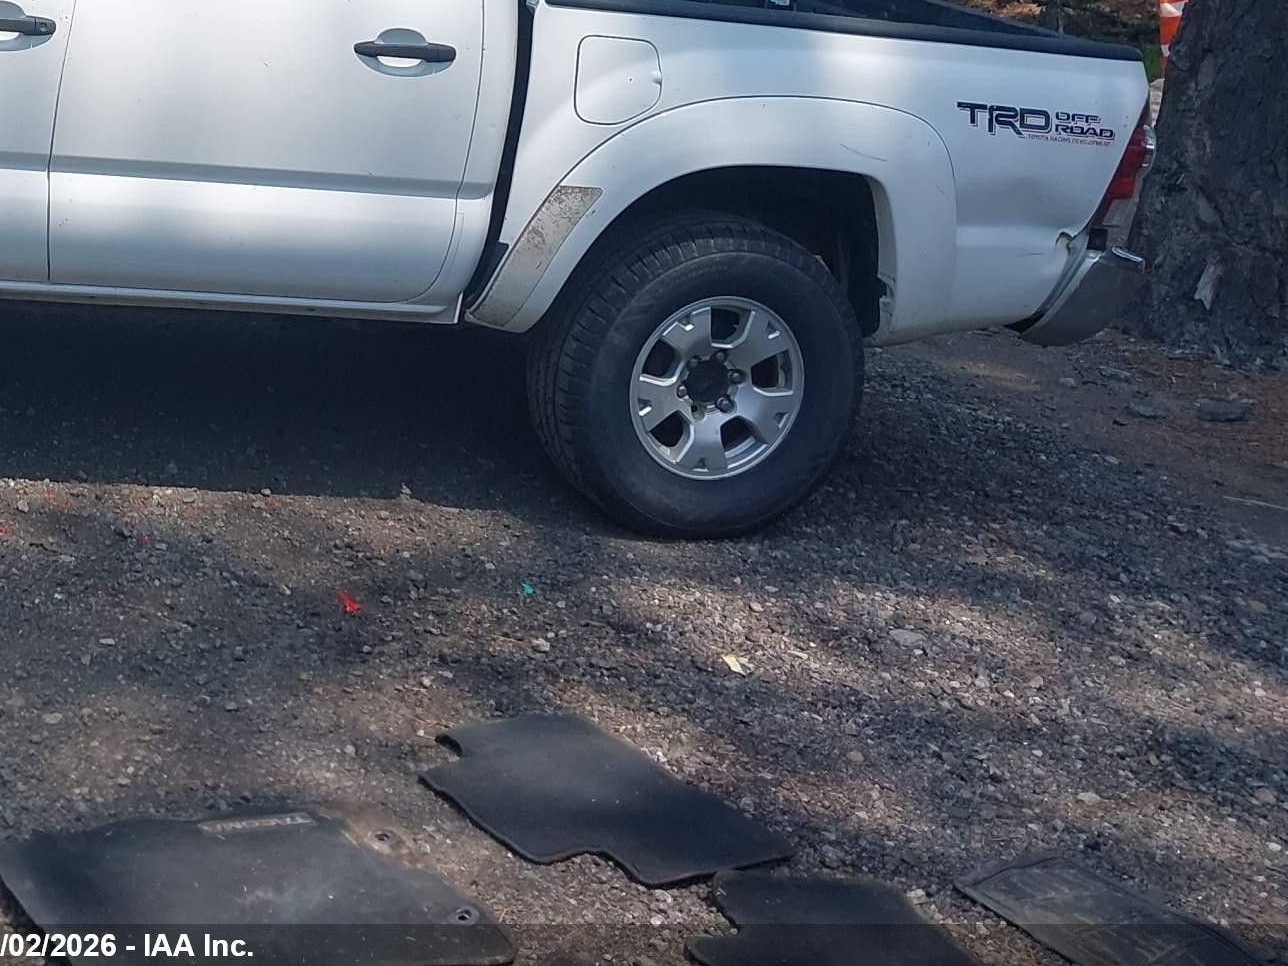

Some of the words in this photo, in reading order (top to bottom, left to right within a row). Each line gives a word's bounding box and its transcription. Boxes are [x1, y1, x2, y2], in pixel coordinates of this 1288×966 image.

[956, 101, 1053, 138] TRD
[1055, 111, 1101, 125] OFF
[1028, 133, 1049, 142] TOYOTA
[1055, 123, 1116, 140] ROAD
